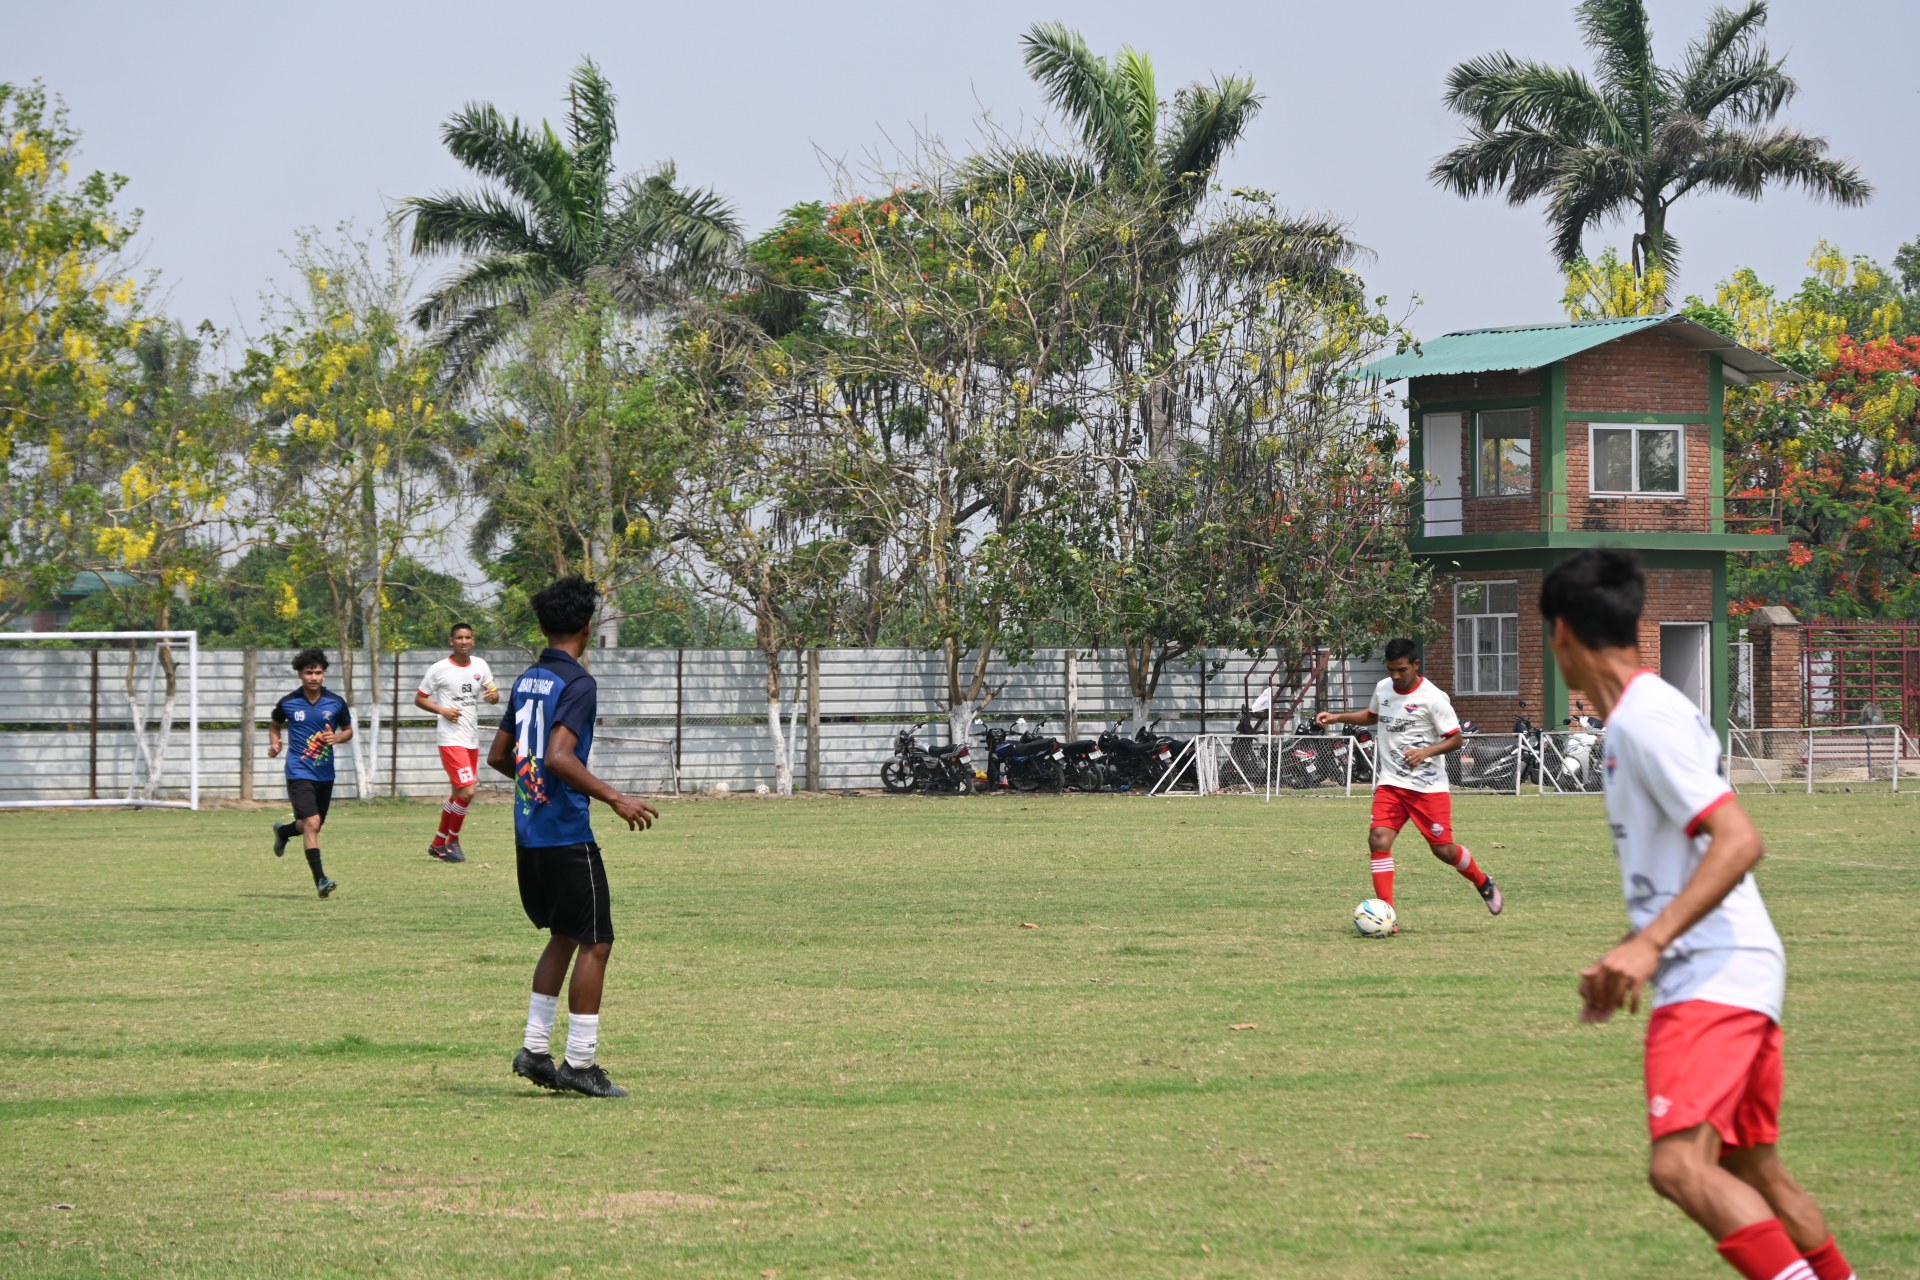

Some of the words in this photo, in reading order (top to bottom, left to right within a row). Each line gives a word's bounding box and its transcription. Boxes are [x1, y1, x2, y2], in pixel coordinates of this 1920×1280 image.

[461, 683, 472, 693] 63
[294, 710, 305, 721] 09
[515, 698, 545, 759] 11
[457, 766, 474, 784] 63
